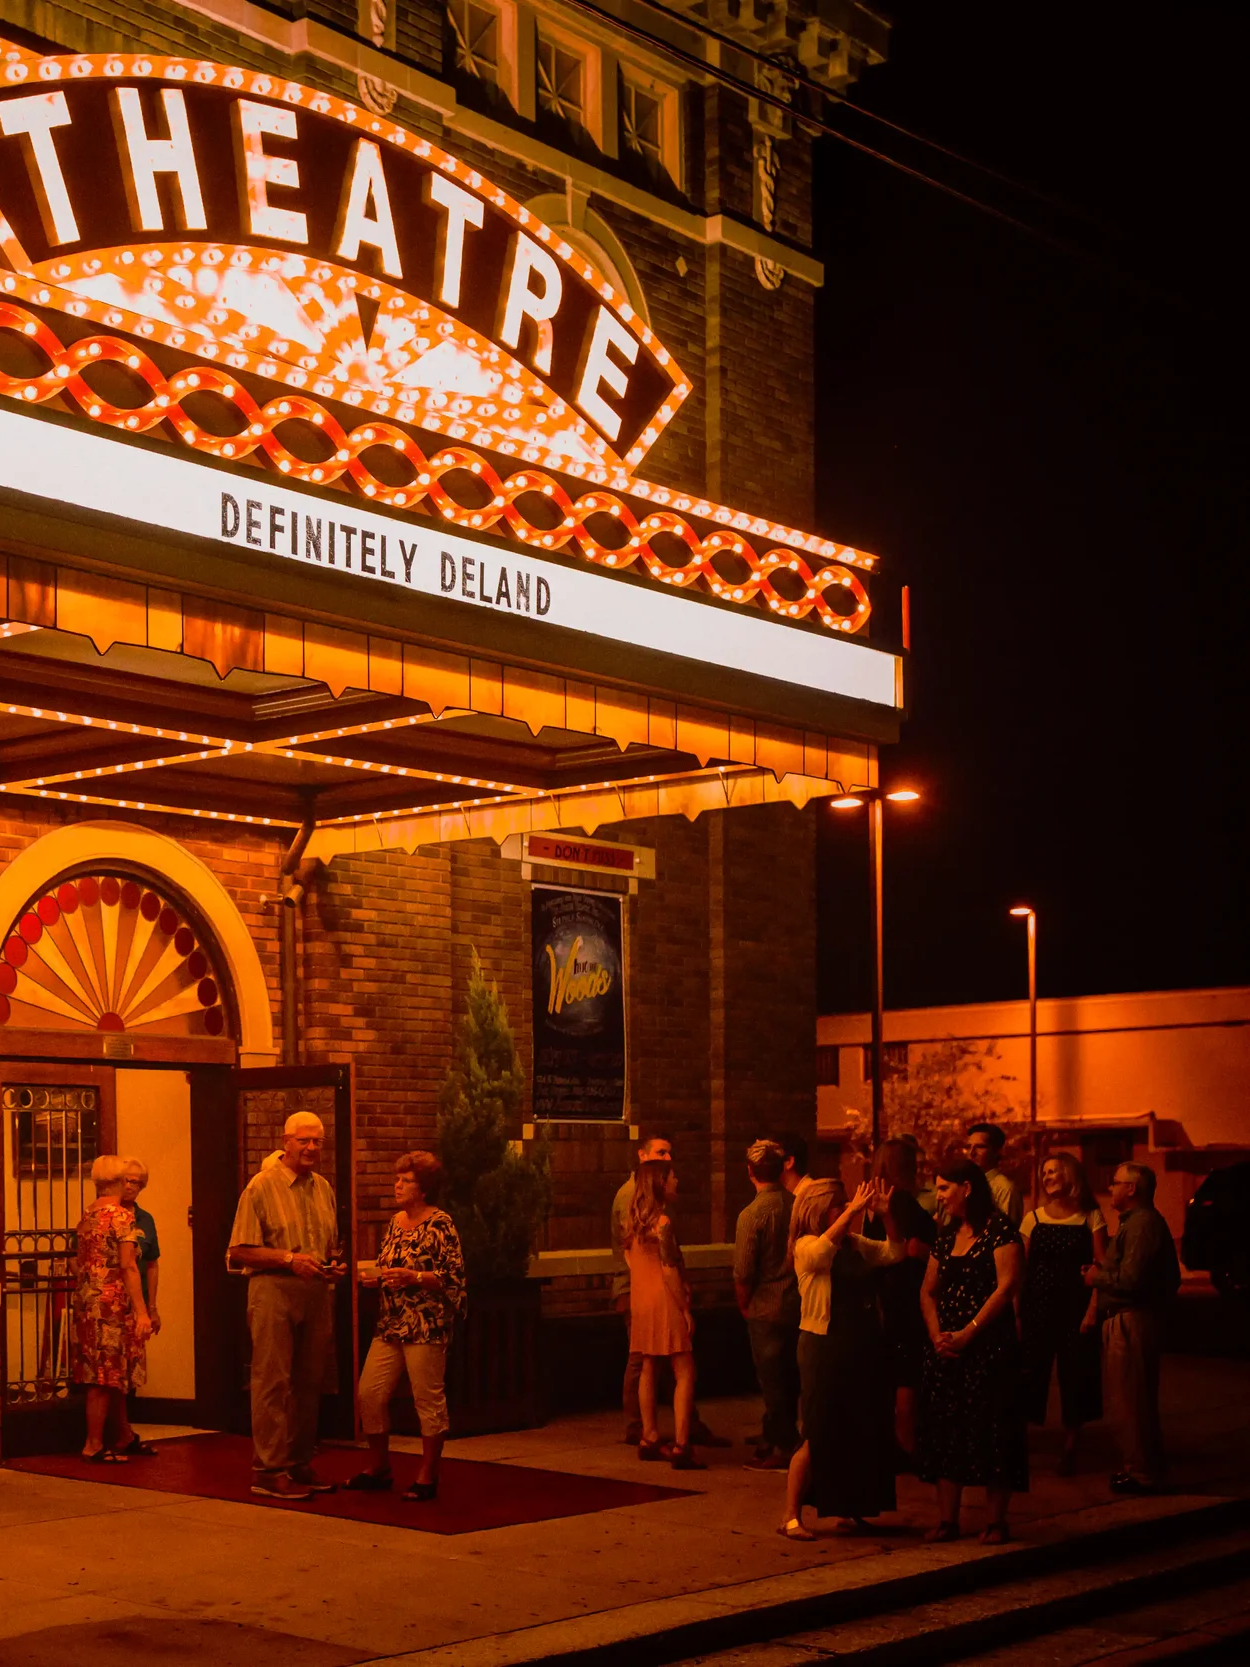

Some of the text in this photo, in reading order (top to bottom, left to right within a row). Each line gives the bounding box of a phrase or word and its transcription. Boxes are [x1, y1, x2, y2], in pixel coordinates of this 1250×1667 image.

[220, 491, 552, 616] DEFINITELY DELAND
[545, 935, 612, 1015] Woods
